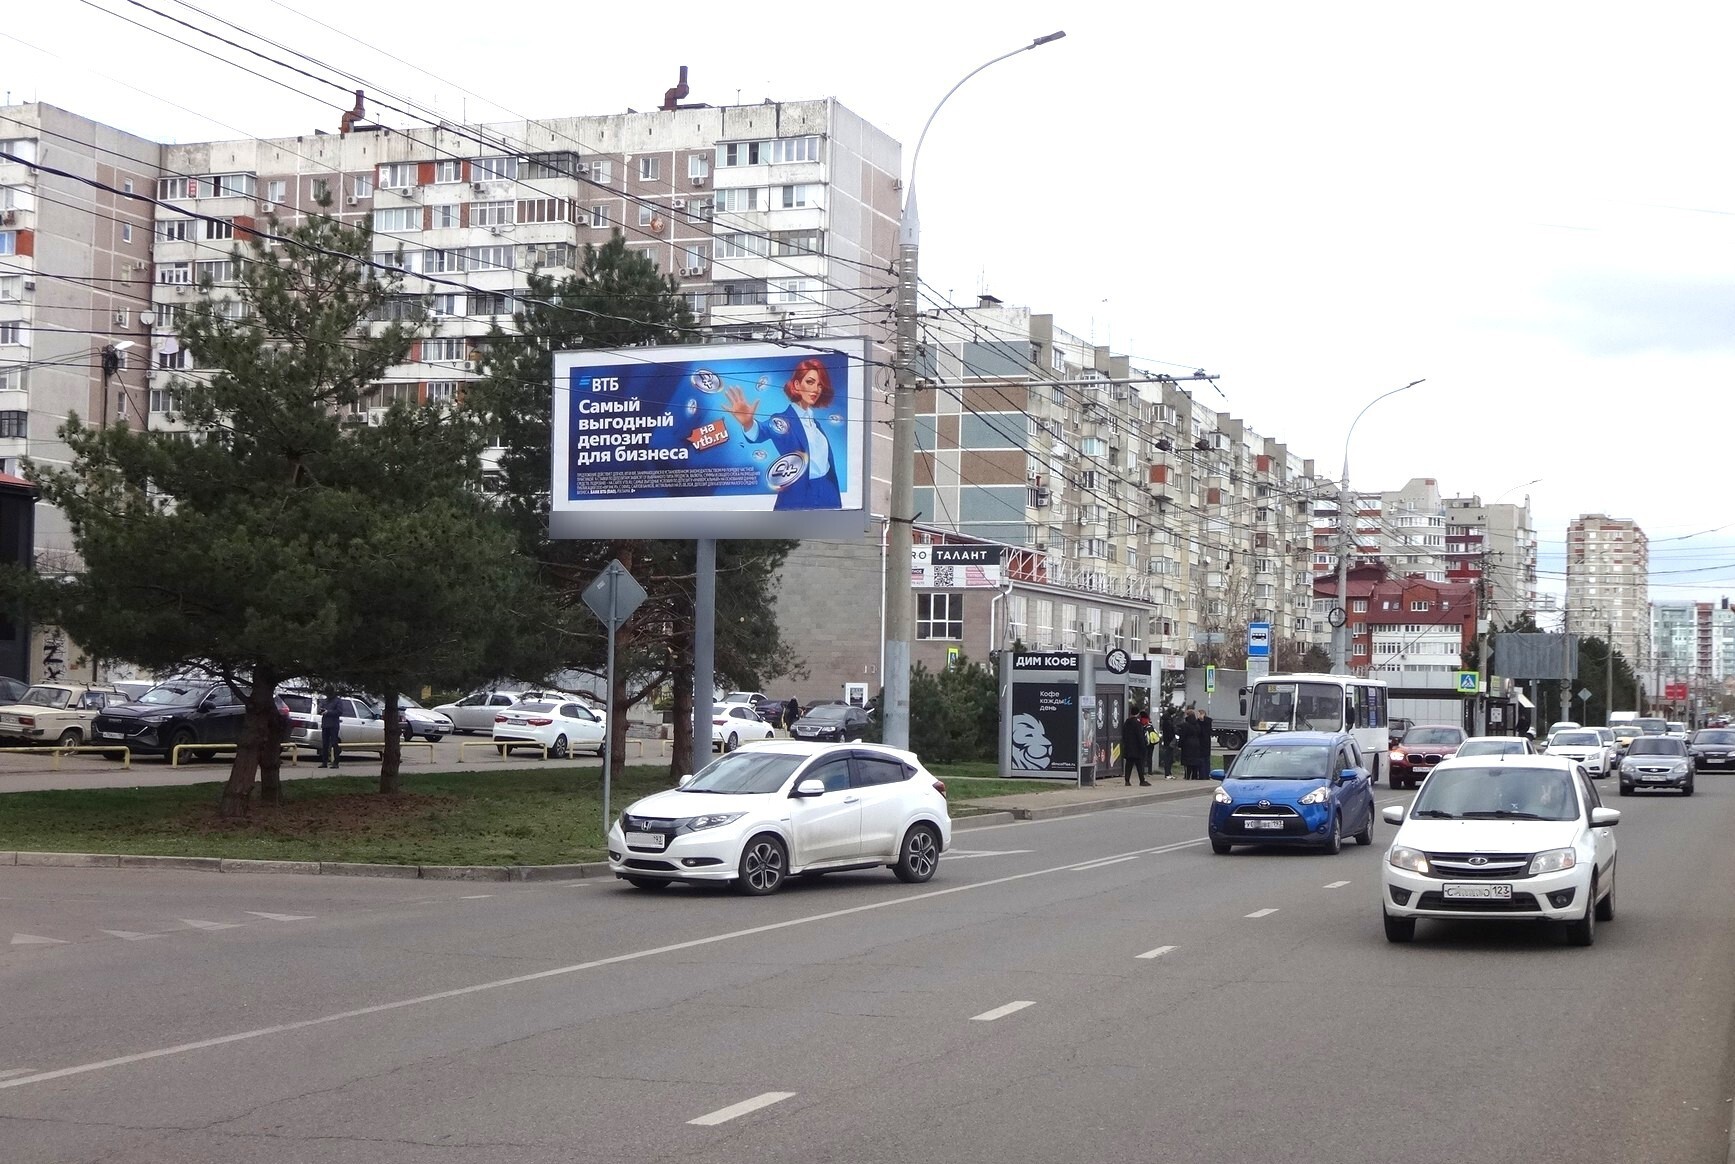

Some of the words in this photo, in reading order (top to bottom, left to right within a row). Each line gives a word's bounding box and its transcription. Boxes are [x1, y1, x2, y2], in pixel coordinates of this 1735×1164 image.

[592, 377, 619, 392] ВТБ
[578, 396, 640, 414] Самый
[578, 411, 674, 431] выгодный
[700, 423, 715, 435] на
[577, 432, 652, 450] депозит
[692, 430, 729, 450] vtb.ru
[577, 450, 611, 466] для
[614, 445, 689, 462] бизнеса
[936, 551, 987, 560] ТАЛАНТ
[1016, 656, 1042, 667] ДИМ
[1044, 656, 1077, 667] КОФЕ
[1040, 690, 1060, 698] Кофе
[1492, 885, 1510, 895] 123
